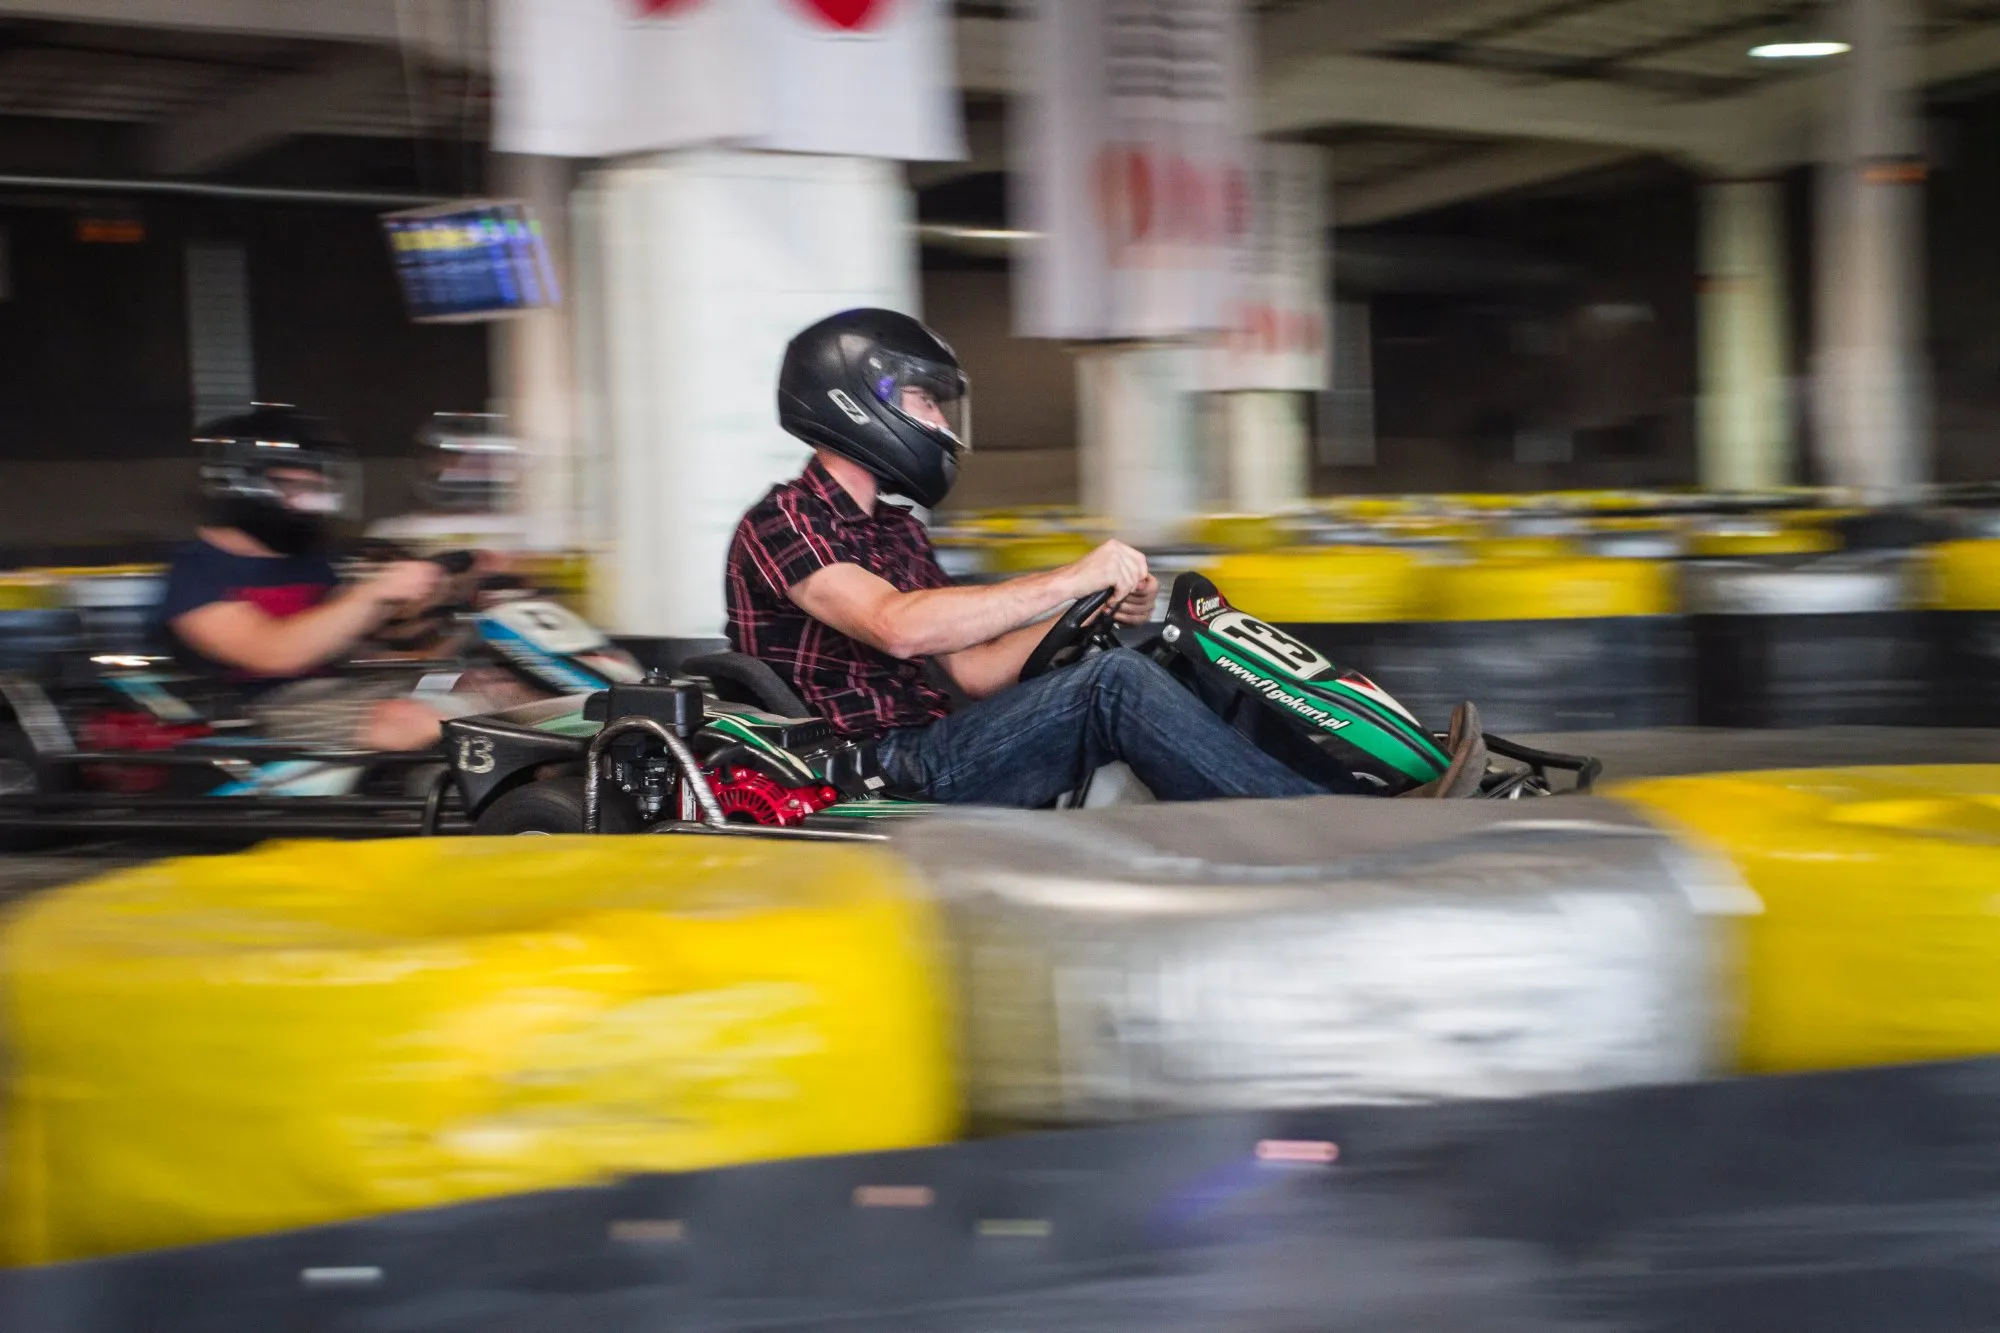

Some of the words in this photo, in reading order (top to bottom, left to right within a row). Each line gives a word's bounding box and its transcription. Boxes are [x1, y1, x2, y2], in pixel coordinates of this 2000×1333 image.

[1222, 619, 1317, 671] 13
[1216, 656, 1351, 730] www.f1gokart.pl
[456, 735, 496, 774] 13
